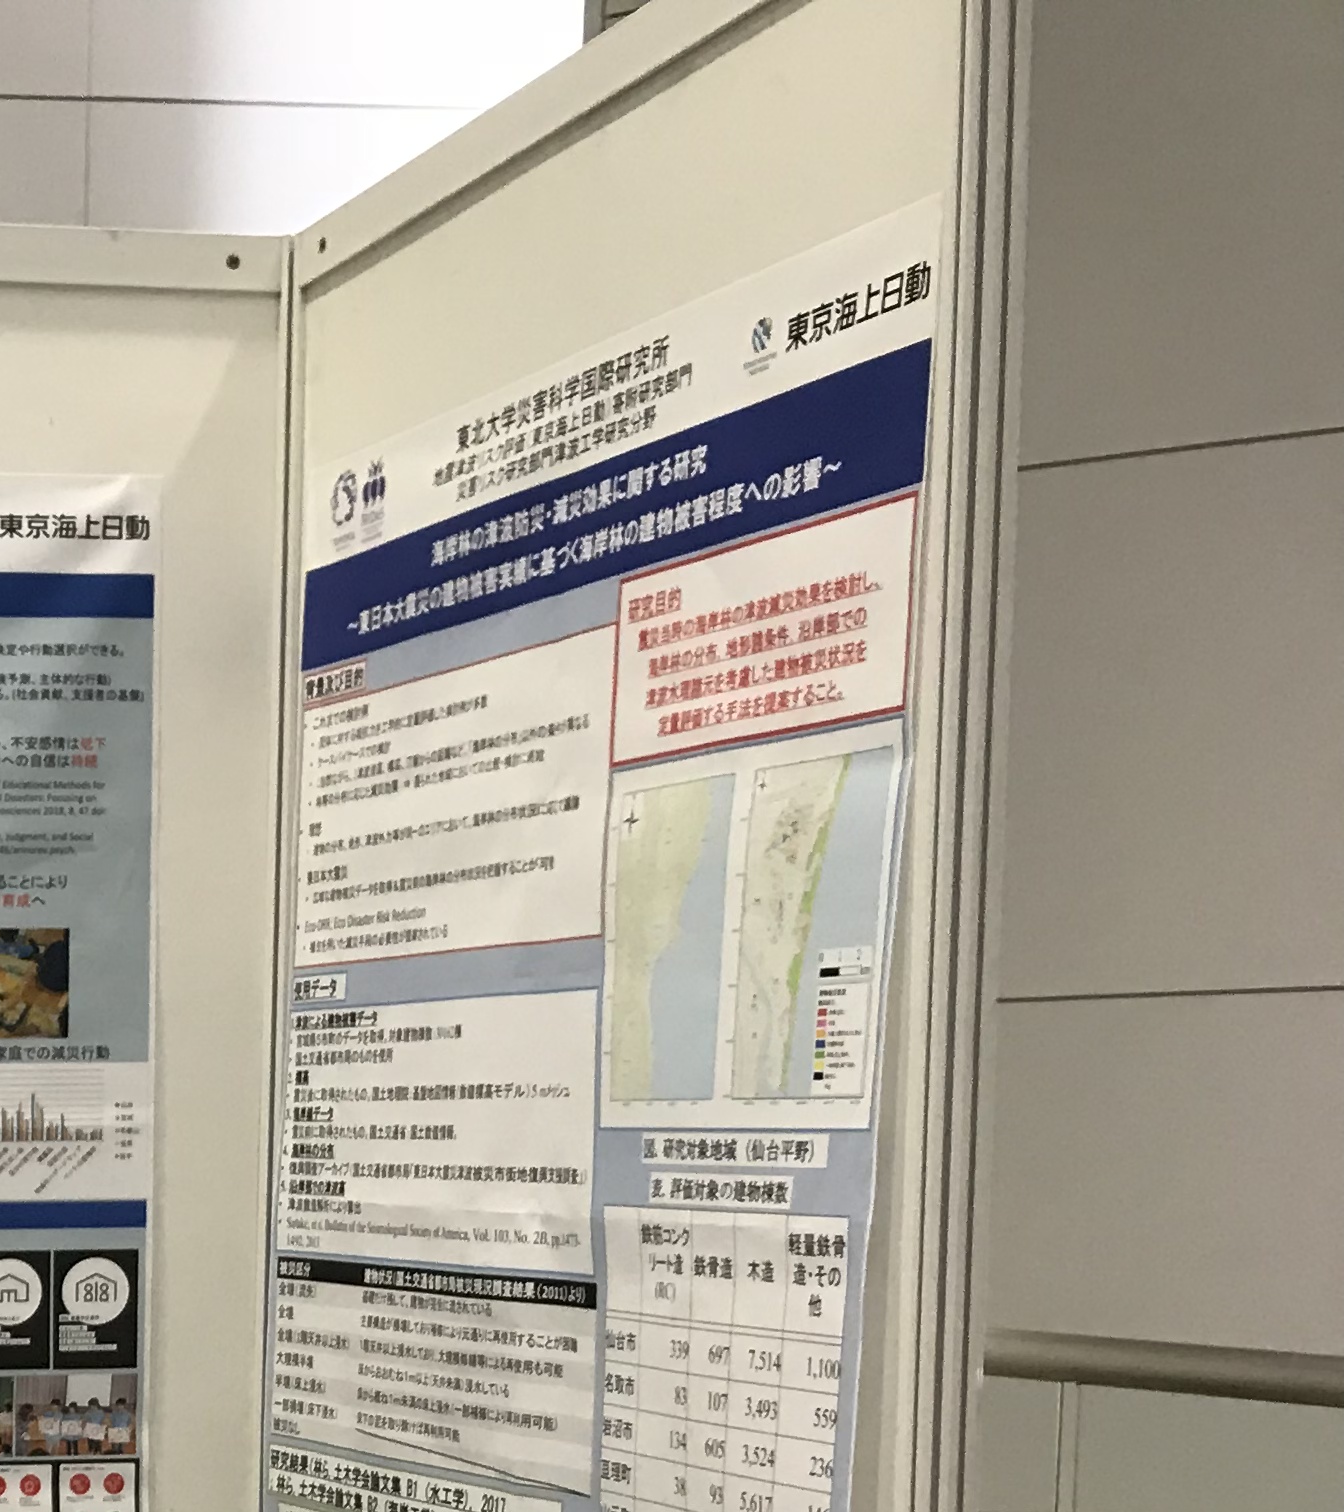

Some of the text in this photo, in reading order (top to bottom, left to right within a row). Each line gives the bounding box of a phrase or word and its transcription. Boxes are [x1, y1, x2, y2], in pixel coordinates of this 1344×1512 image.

[787, 260, 931, 353] 東京海上日動
[456, 335, 670, 454] 東北大学災害科学国際研究所
[747, 1260, 775, 1283] 木造
[748, 1349, 841, 1380] 7,514 1,100
[707, 1391, 728, 1412] 107
[745, 1397, 778, 1421] 3,493
[813, 1407, 838, 1430] 559
